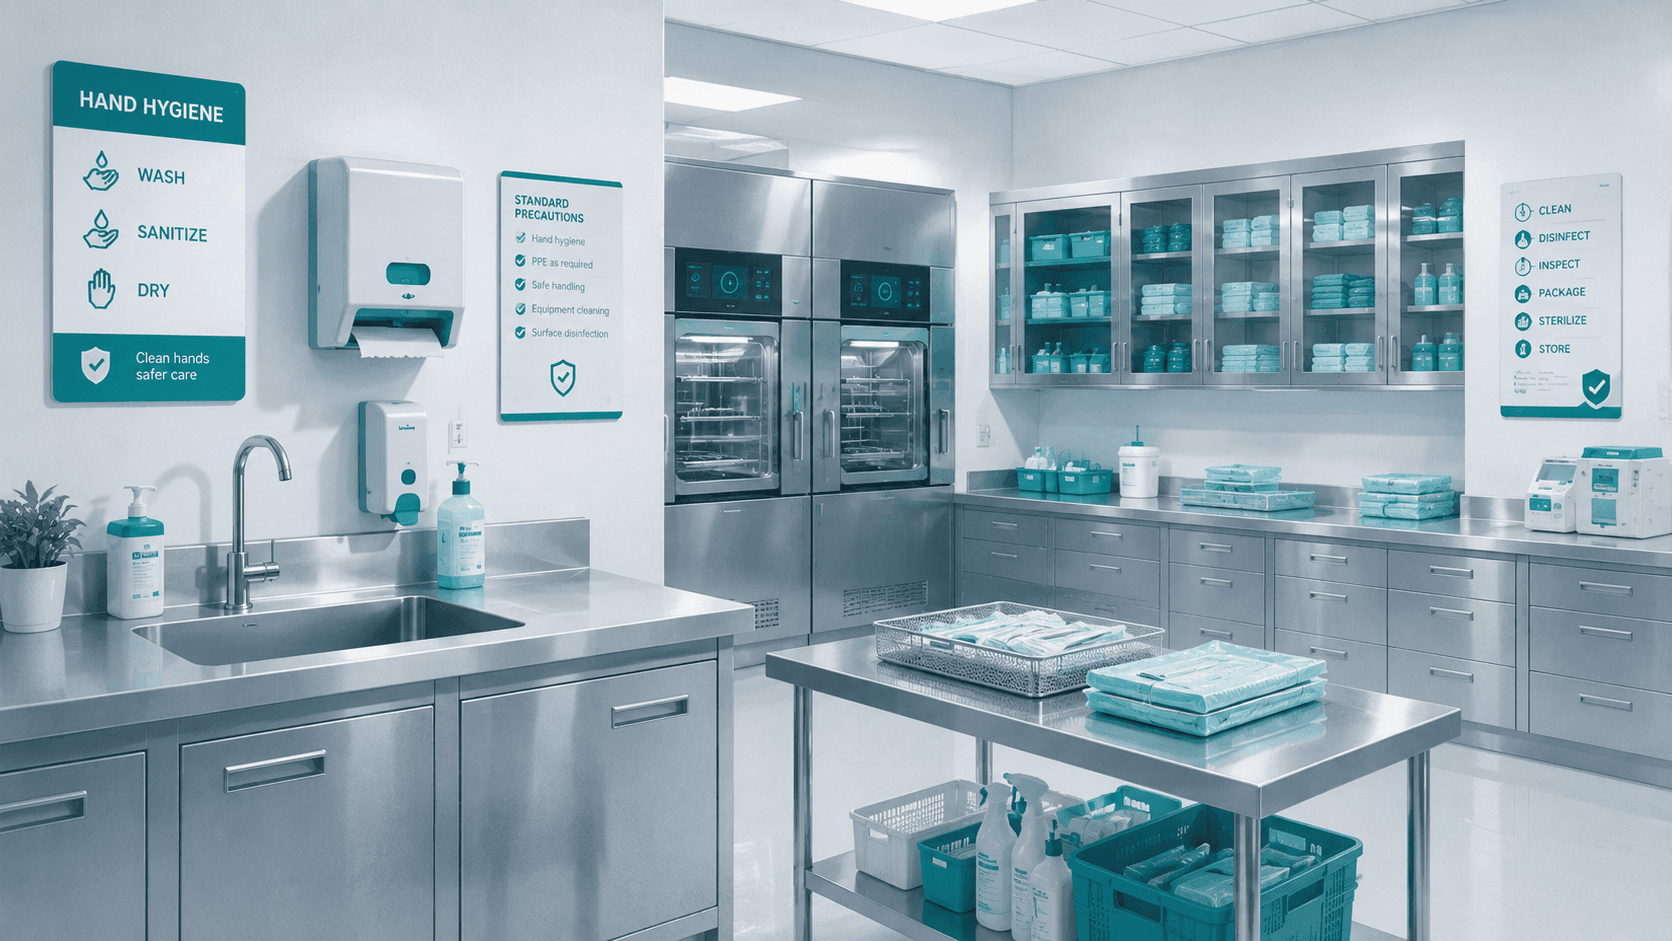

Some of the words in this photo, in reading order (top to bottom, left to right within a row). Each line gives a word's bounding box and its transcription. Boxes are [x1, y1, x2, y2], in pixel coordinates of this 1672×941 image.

[80, 91, 137, 113] HAND
[143, 98, 224, 123] HYGIENE
[137, 168, 185, 185] WASH
[514, 194, 570, 208] STANDARD
[514, 208, 585, 224] PRECAUTIONS
[1538, 204, 1572, 216] CLEAN
[137, 225, 208, 243] SANITIZE
[1538, 231, 1591, 243] DISINFECT
[531, 234, 553, 244] Hand
[554, 236, 586, 248] hygiene
[531, 257, 548, 267] PPE
[549, 260, 559, 268] as
[560, 260, 594, 270] required
[1538, 259, 1581, 271] INSPECT
[137, 283, 170, 298] DRY
[531, 280, 550, 290] Safe
[551, 282, 586, 294] handling
[1538, 287, 1586, 298] PACKAGE
[531, 304, 575, 316] Equipment
[576, 306, 610, 318] cleaning
[1538, 315, 1587, 326] STERILIZE
[531, 328, 563, 338] Surface
[563, 329, 609, 339] disinfection
[1538, 344, 1571, 354] STORE
[135, 352, 170, 364] Clean
[173, 352, 210, 365] hands
[135, 368, 168, 381] safer
[170, 371, 198, 381] care
